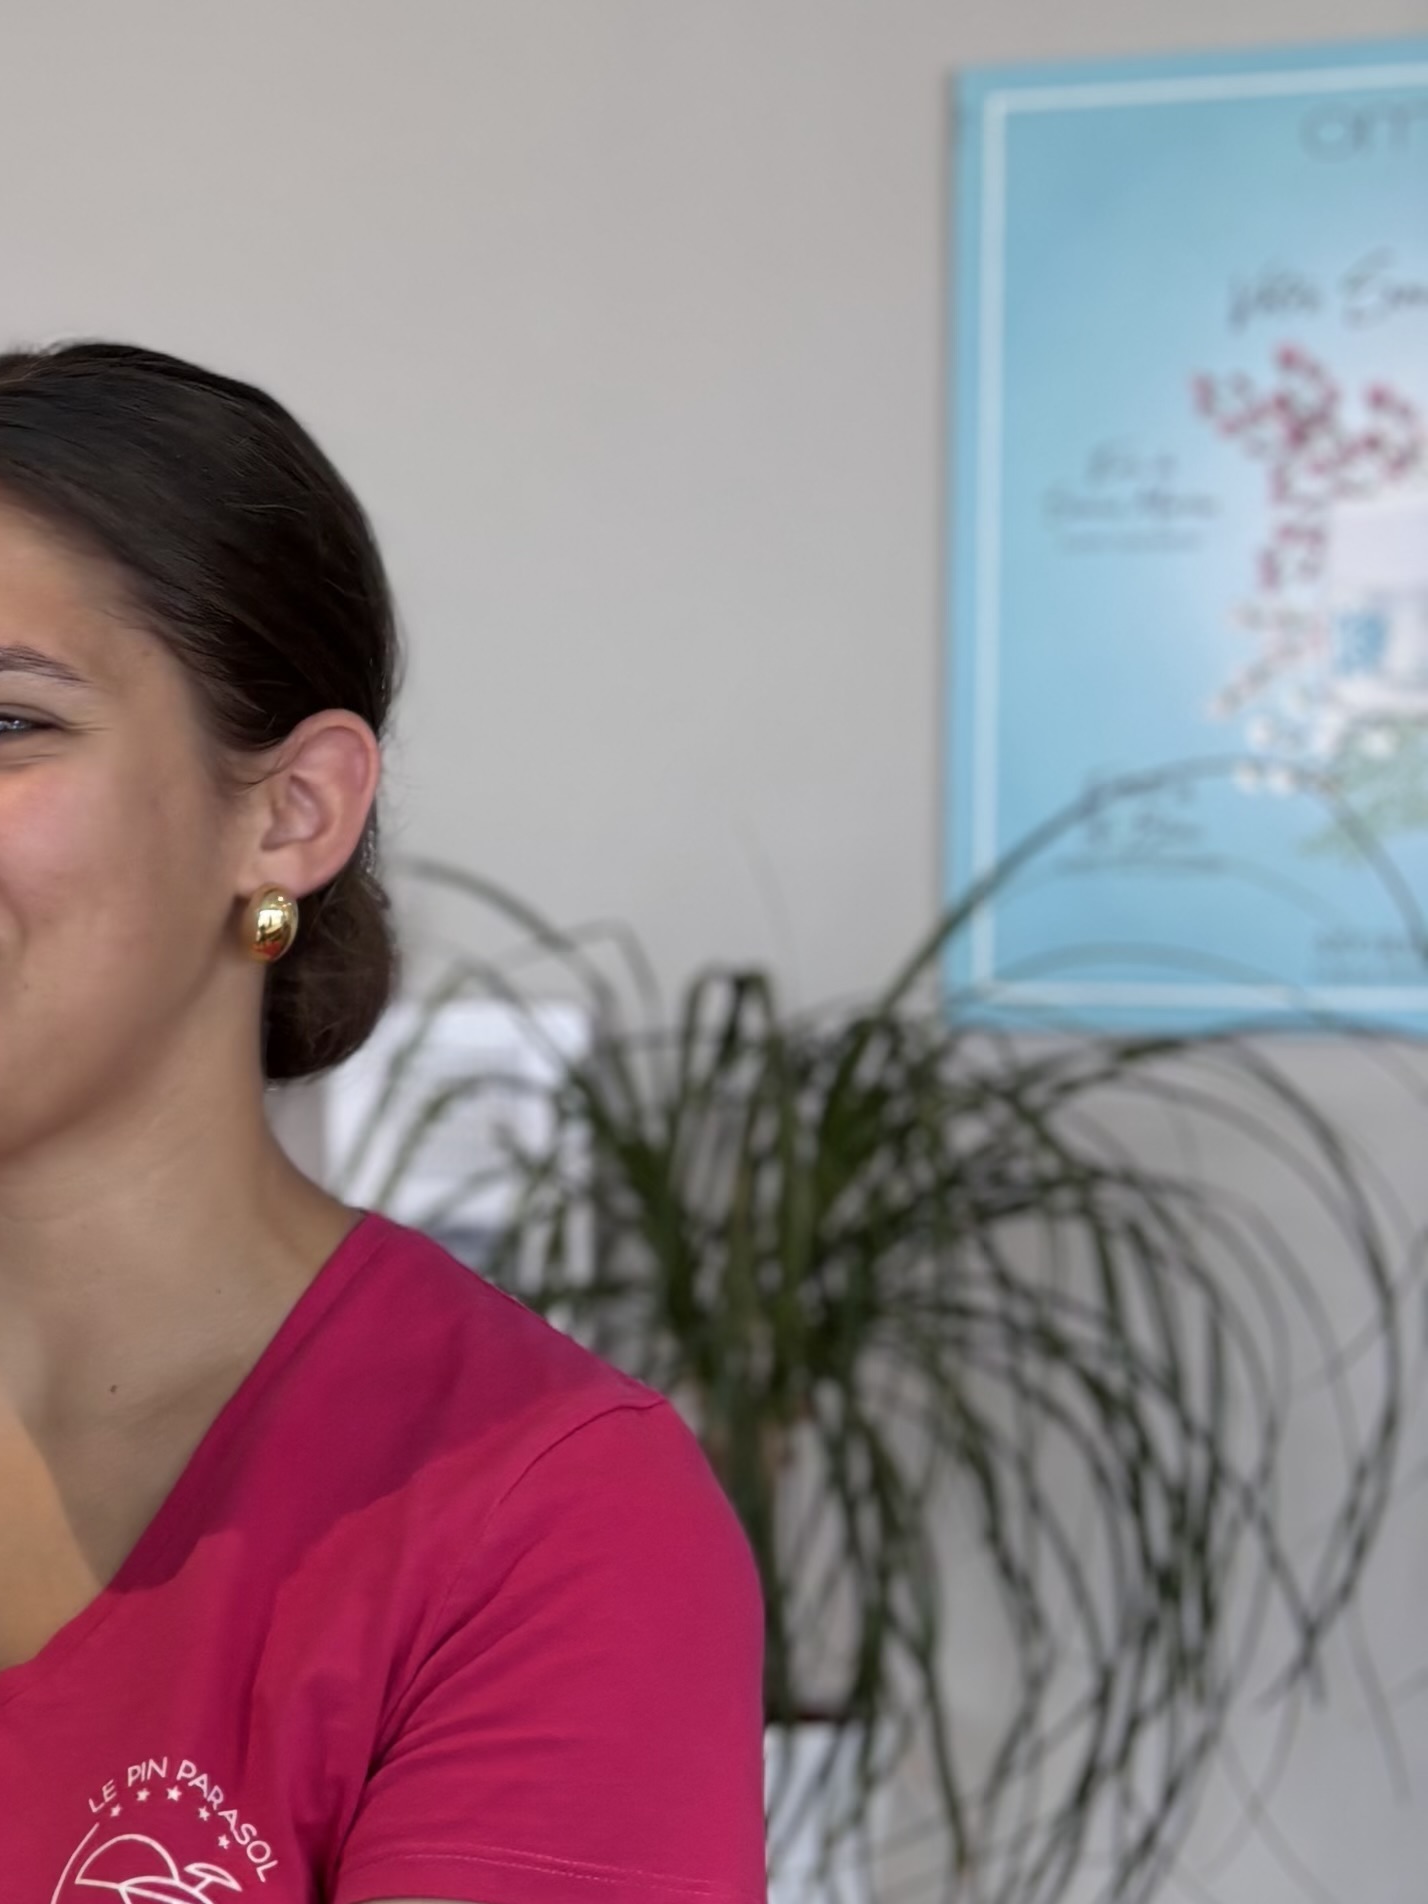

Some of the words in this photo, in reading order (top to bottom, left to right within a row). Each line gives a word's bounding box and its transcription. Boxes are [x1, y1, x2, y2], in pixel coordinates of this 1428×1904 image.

[88, 1779, 118, 1813] LE
[127, 1756, 168, 1787] PIN
[176, 1759, 278, 1883] PARASOL
